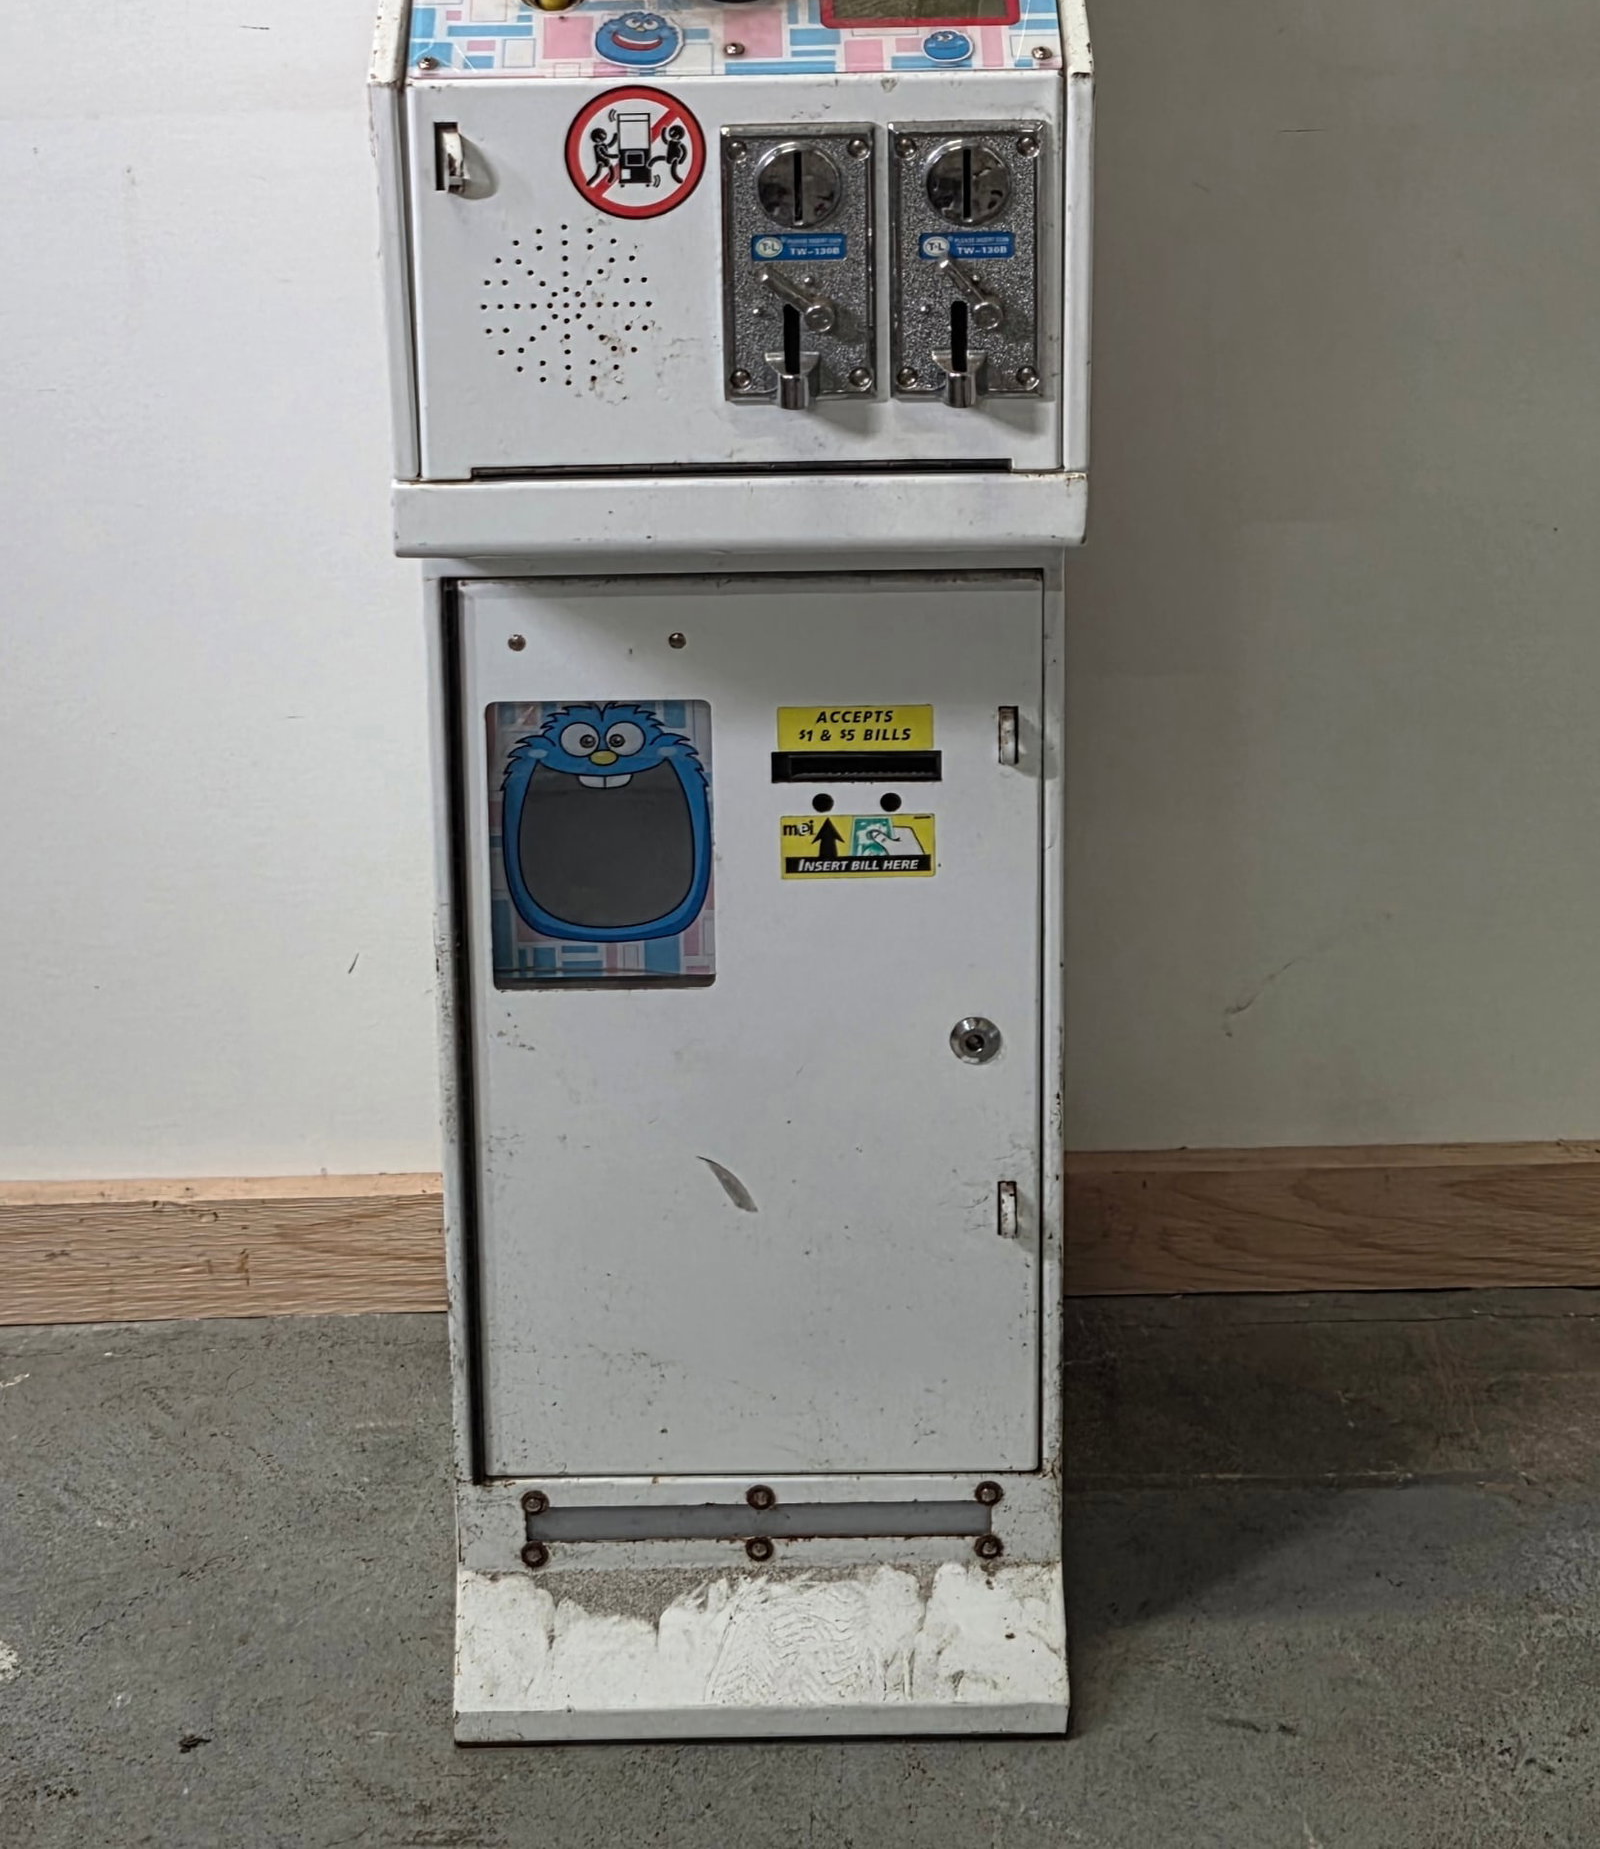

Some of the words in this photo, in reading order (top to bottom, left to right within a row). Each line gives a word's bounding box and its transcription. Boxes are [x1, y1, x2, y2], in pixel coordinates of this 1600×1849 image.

[957, 246, 1007, 254] TW-130B
[816, 710, 894, 724] ACCEPTS
[799, 729, 814, 742] $1
[820, 730, 832, 742] &
[840, 729, 855, 742] $5
[863, 728, 912, 741] BILLS
[783, 820, 816, 836] mei
[798, 858, 848, 872] INSERT
[850, 859, 880, 871] BILL
[882, 859, 919, 870] HERE
